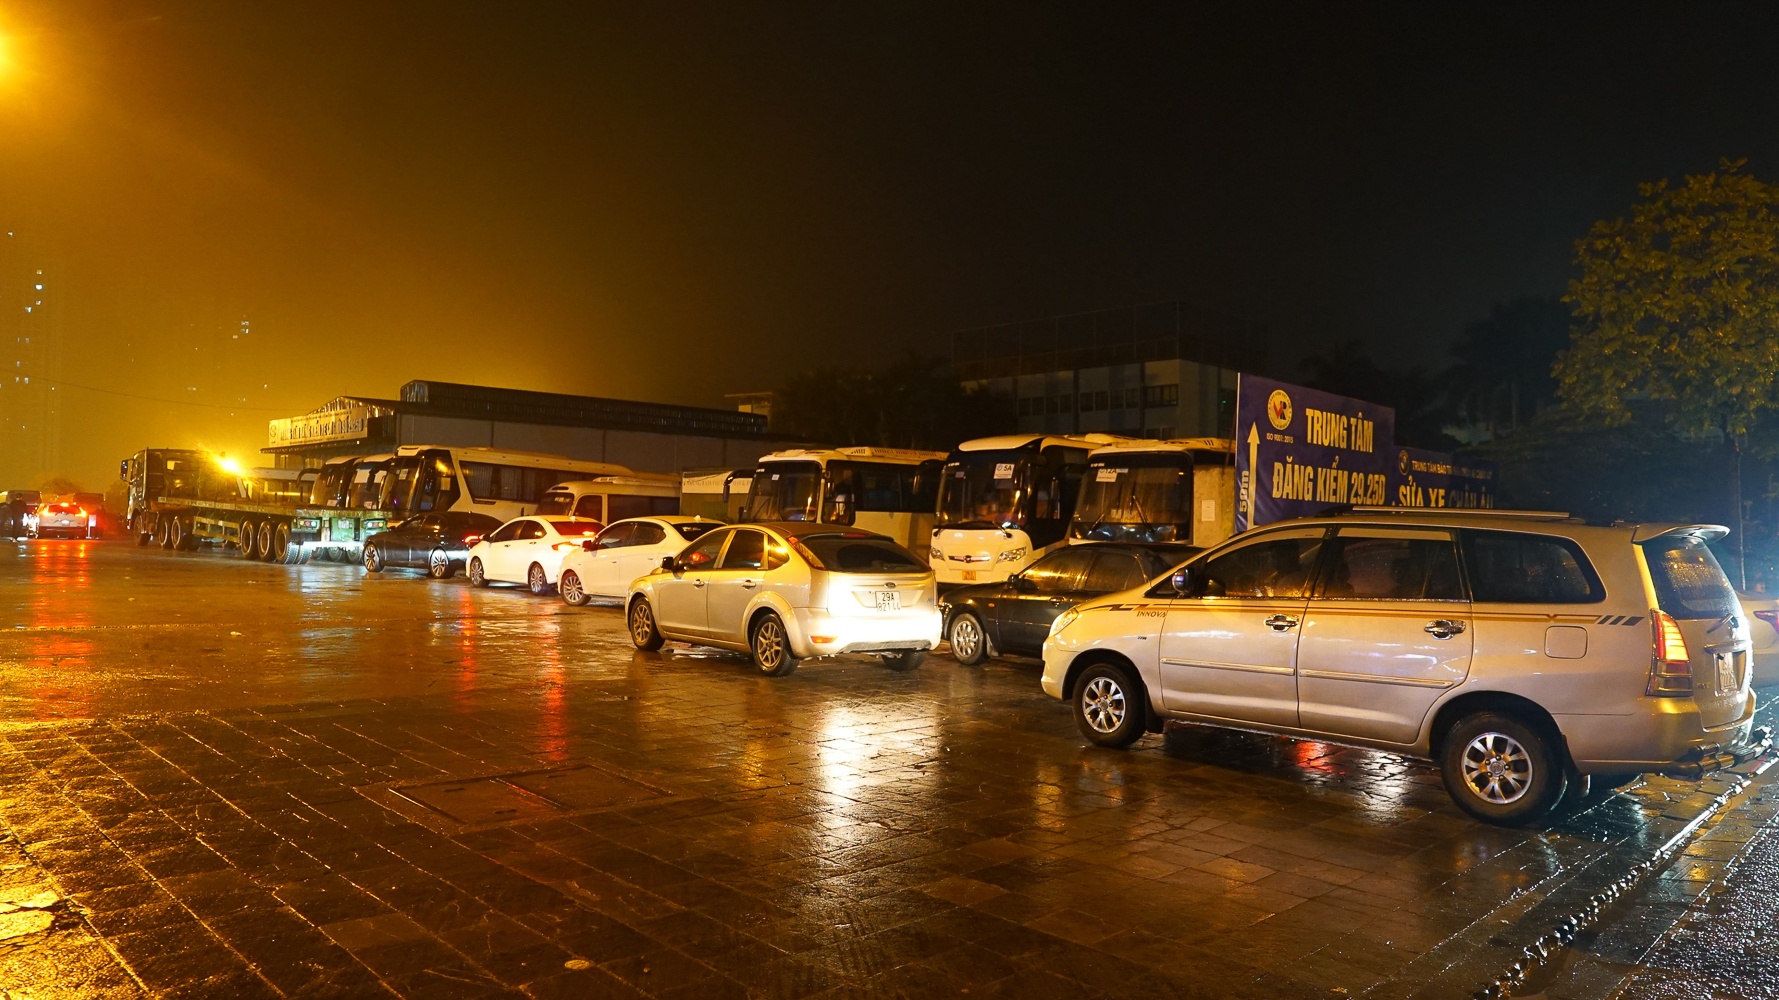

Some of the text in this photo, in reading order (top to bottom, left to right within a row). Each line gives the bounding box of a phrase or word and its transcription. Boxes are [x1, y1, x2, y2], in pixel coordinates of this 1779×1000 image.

[1266, 432, 1274, 441] ISO
[1305, 407, 1374, 453] TRUNG TÂM
[1412, 461, 1427, 472] TRUNG
[1239, 470, 1250, 513] 50m
[1272, 455, 1386, 506] ĐĂNG KIỂM 29.25D
[1399, 474, 1424, 507] SỬA
[1428, 487, 1446, 508] XE
[881, 592, 895, 602] 29A
[1136, 610, 1167, 618] INNOVA
